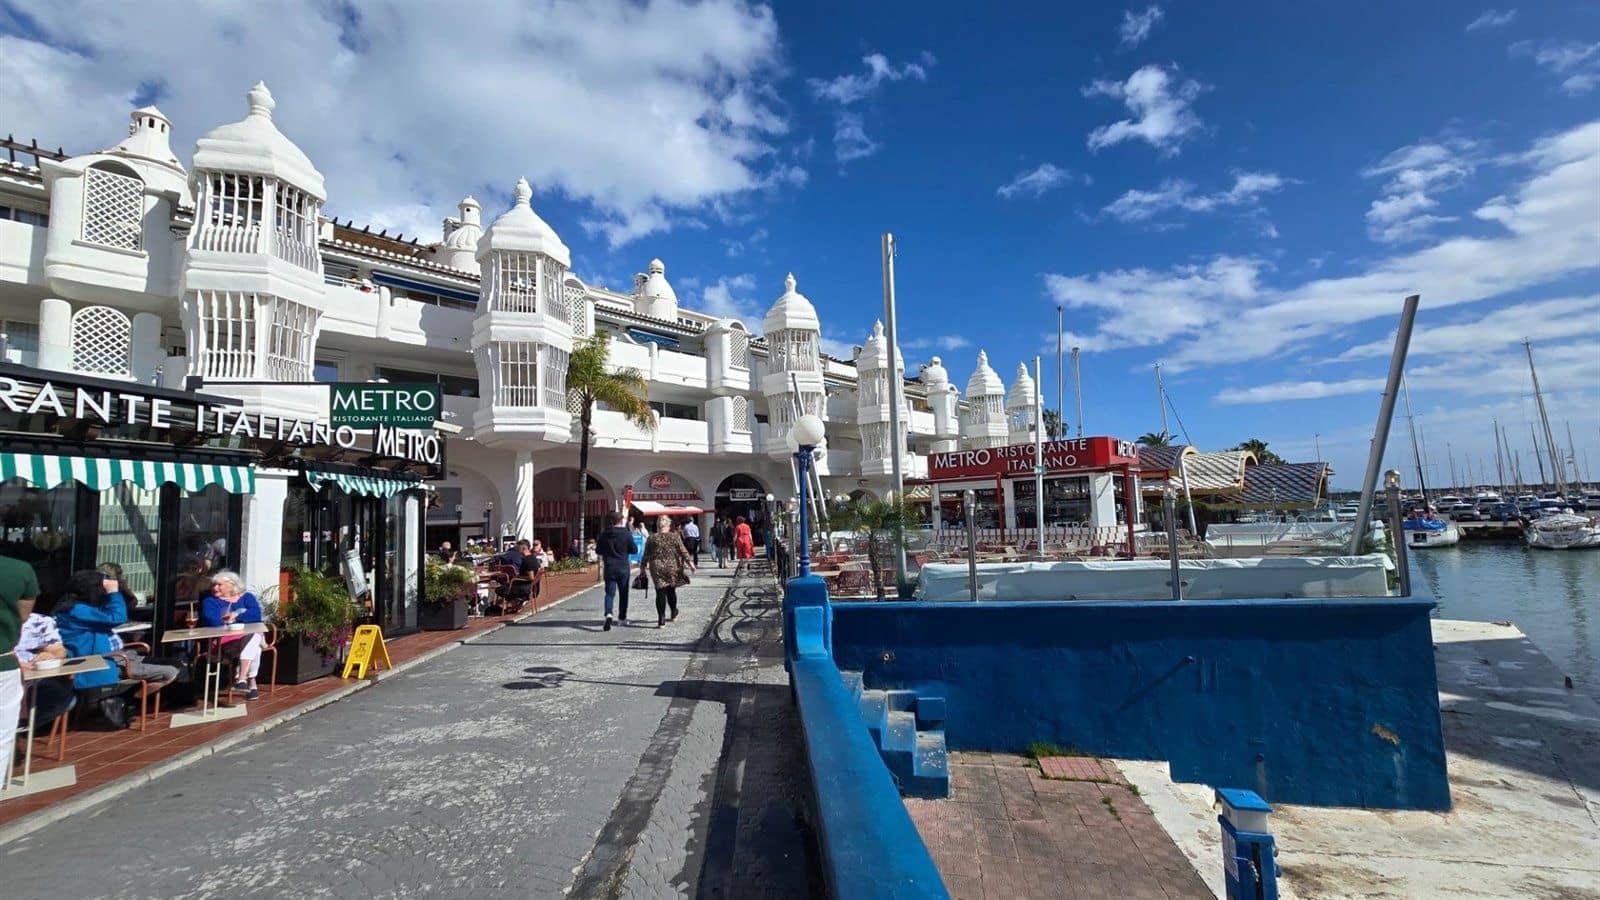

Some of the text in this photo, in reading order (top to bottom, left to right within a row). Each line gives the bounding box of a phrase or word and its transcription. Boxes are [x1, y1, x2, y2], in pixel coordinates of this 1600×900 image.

[332, 389, 435, 411] METRO
[196, 405, 356, 448] ITALIANO
[376, 423, 439, 464] METRO
[934, 449, 991, 469] METRO
[1006, 454, 1077, 471] ITALANO
